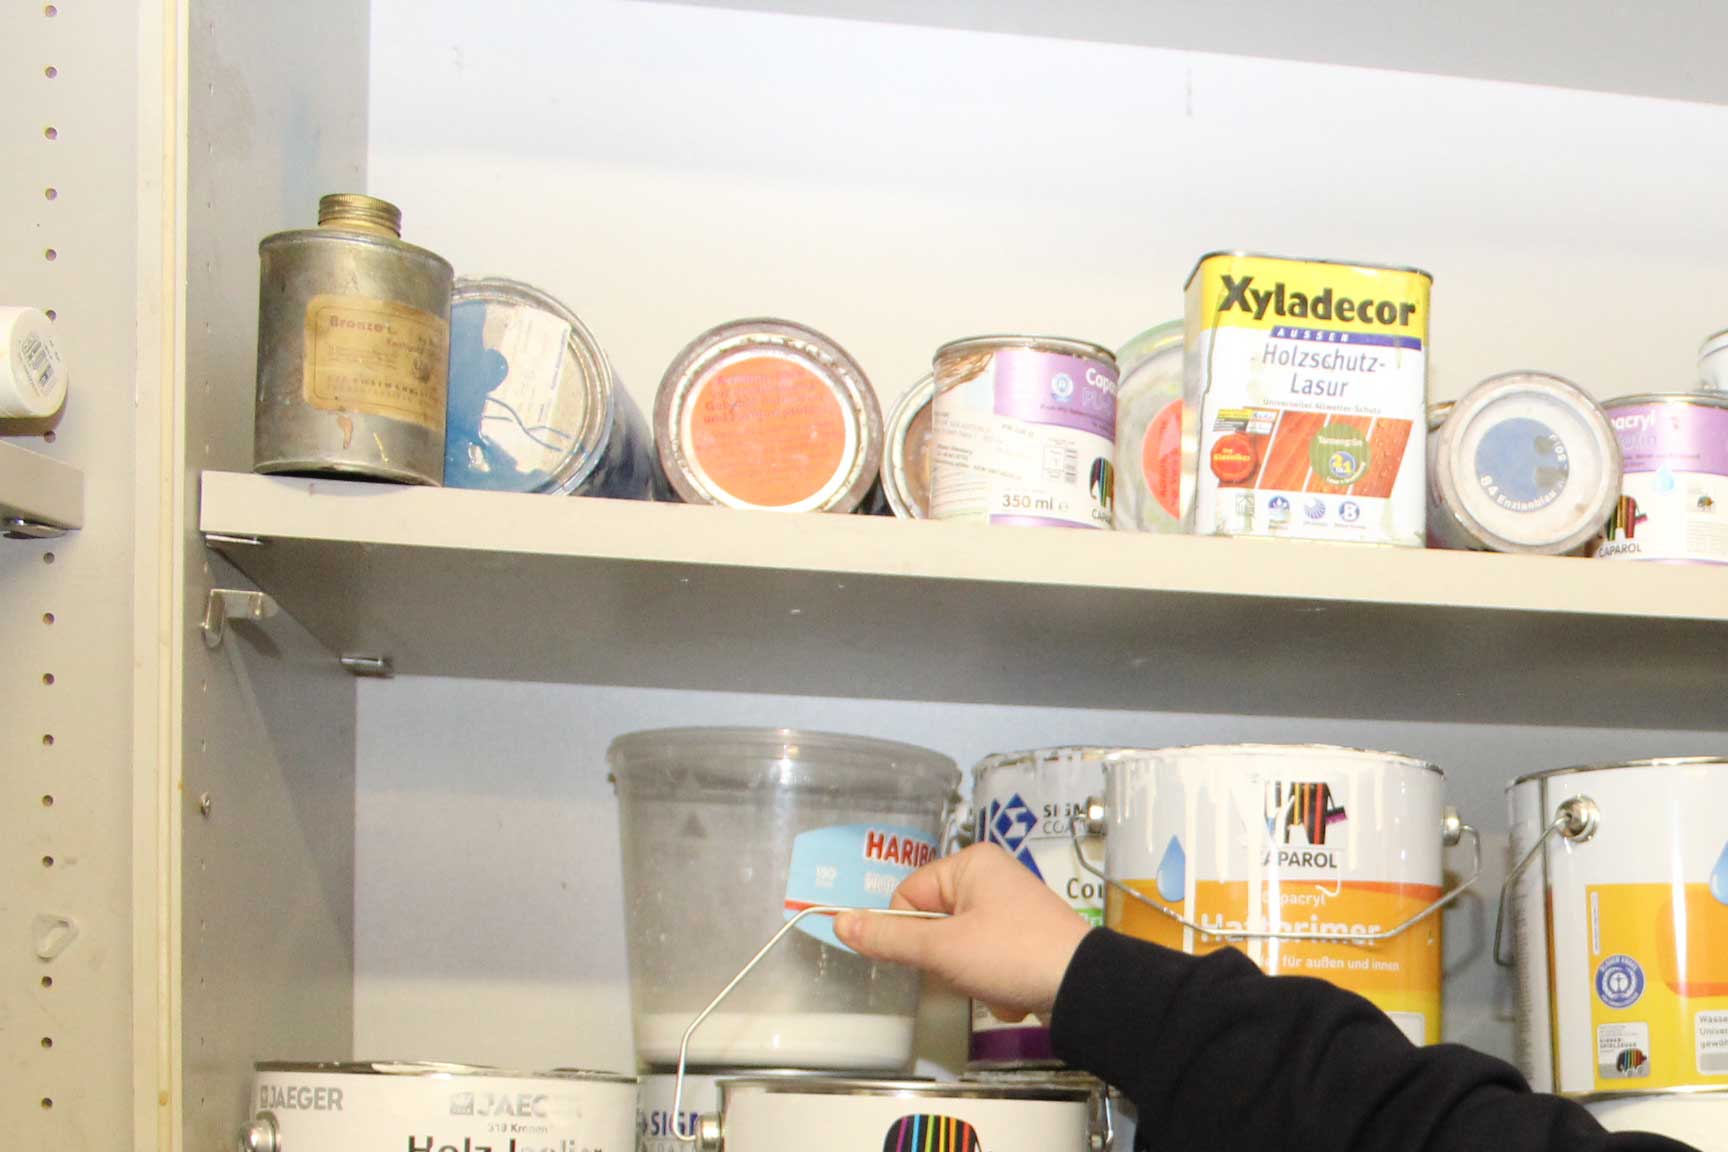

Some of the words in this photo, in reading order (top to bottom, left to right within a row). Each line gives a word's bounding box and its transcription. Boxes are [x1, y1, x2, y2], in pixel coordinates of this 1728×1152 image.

[1218, 274, 1417, 328] Xyladecor
[1262, 341, 1387, 374] Holzschutz-
[1290, 371, 1350, 398] Lasur
[1002, 494, 1031, 508] 350
[1035, 496, 1054, 510] ml
[1347, 957, 1369, 969] und
[269, 1085, 344, 1111] JAEGER
